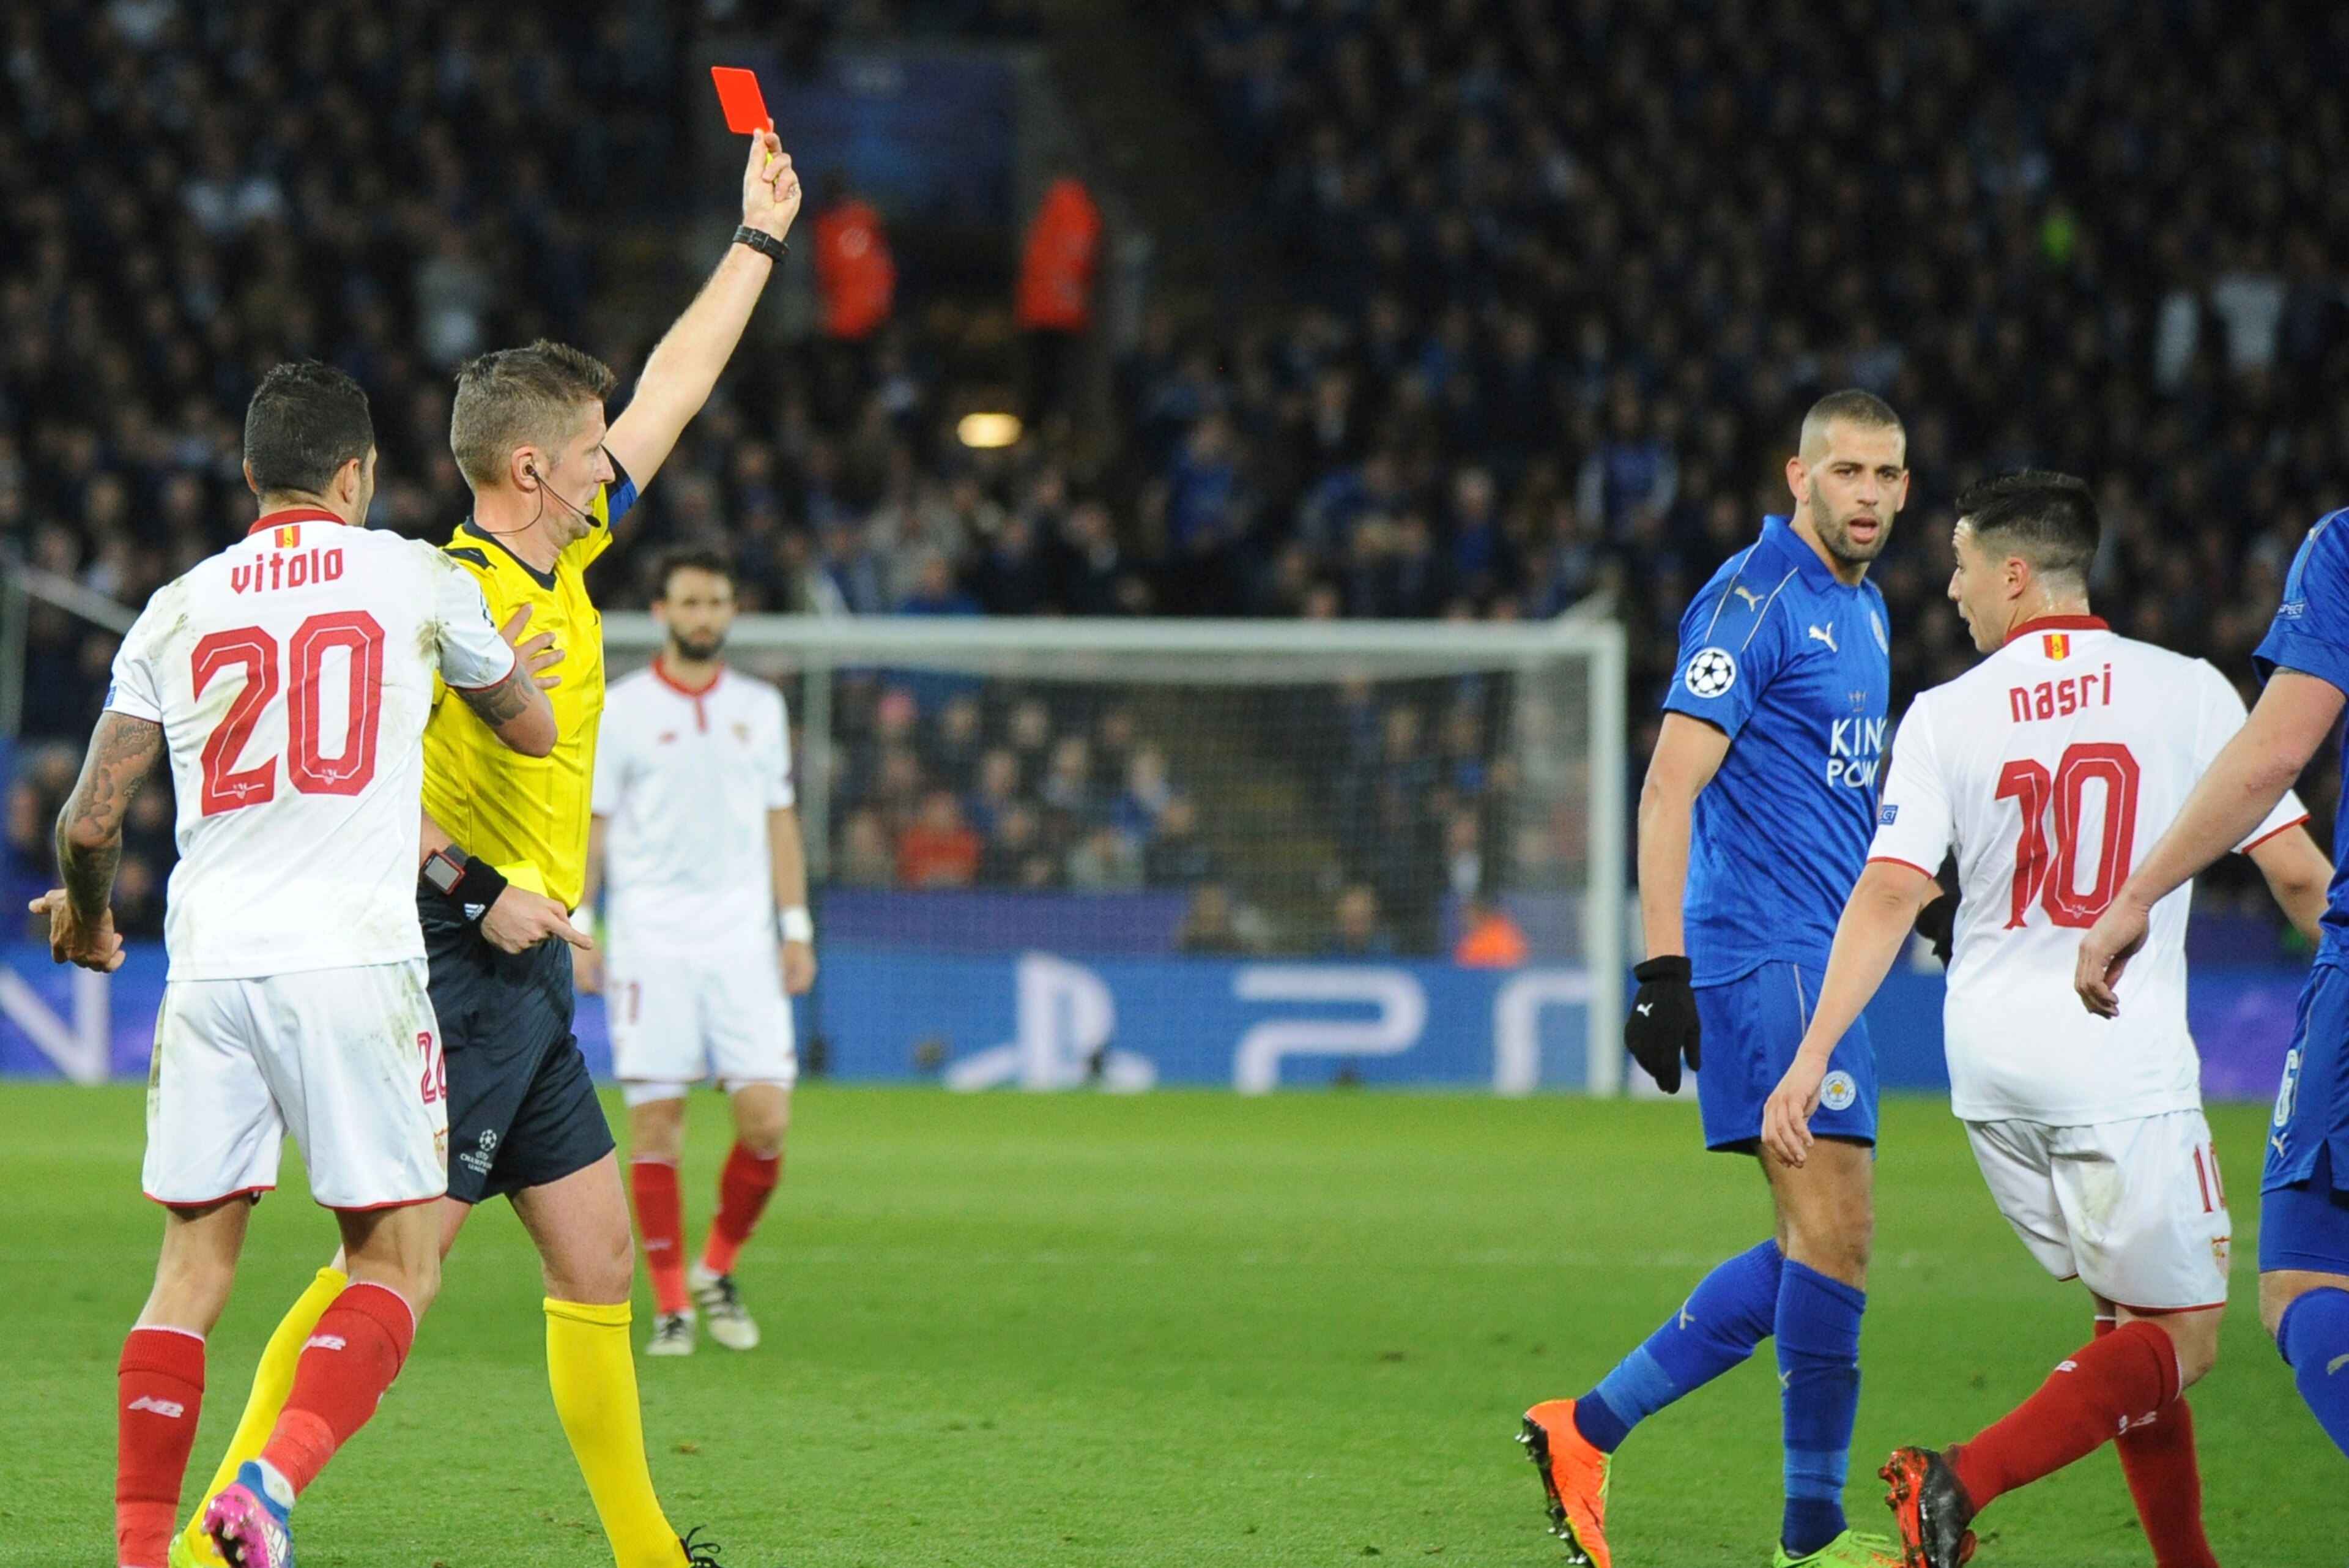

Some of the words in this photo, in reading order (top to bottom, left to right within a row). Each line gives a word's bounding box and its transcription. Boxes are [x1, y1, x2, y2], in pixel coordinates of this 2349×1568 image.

[231, 548, 343, 595] vitolo
[191, 611, 385, 817] 20
[2009, 663, 2111, 723] nasri
[1830, 716, 1887, 757] KIN
[1995, 743, 2140, 929] 10
[2274, 1049, 2298, 1127] 6
